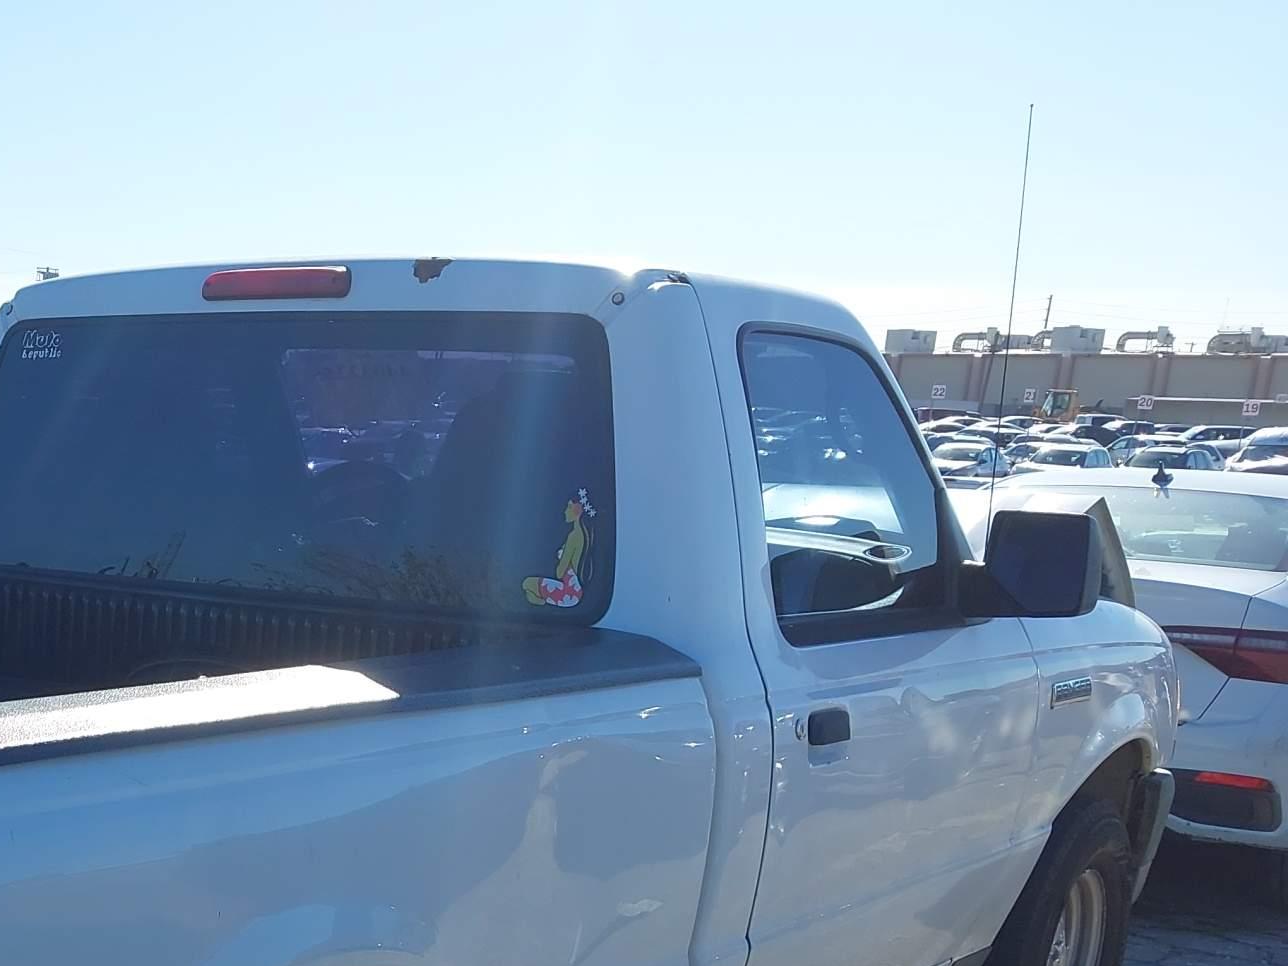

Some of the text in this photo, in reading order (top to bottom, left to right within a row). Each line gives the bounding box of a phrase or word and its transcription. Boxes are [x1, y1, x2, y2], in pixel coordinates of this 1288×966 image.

[933, 386, 945, 397] 22
[1139, 397, 1154, 408] 20
[1243, 402, 1259, 414] 19
